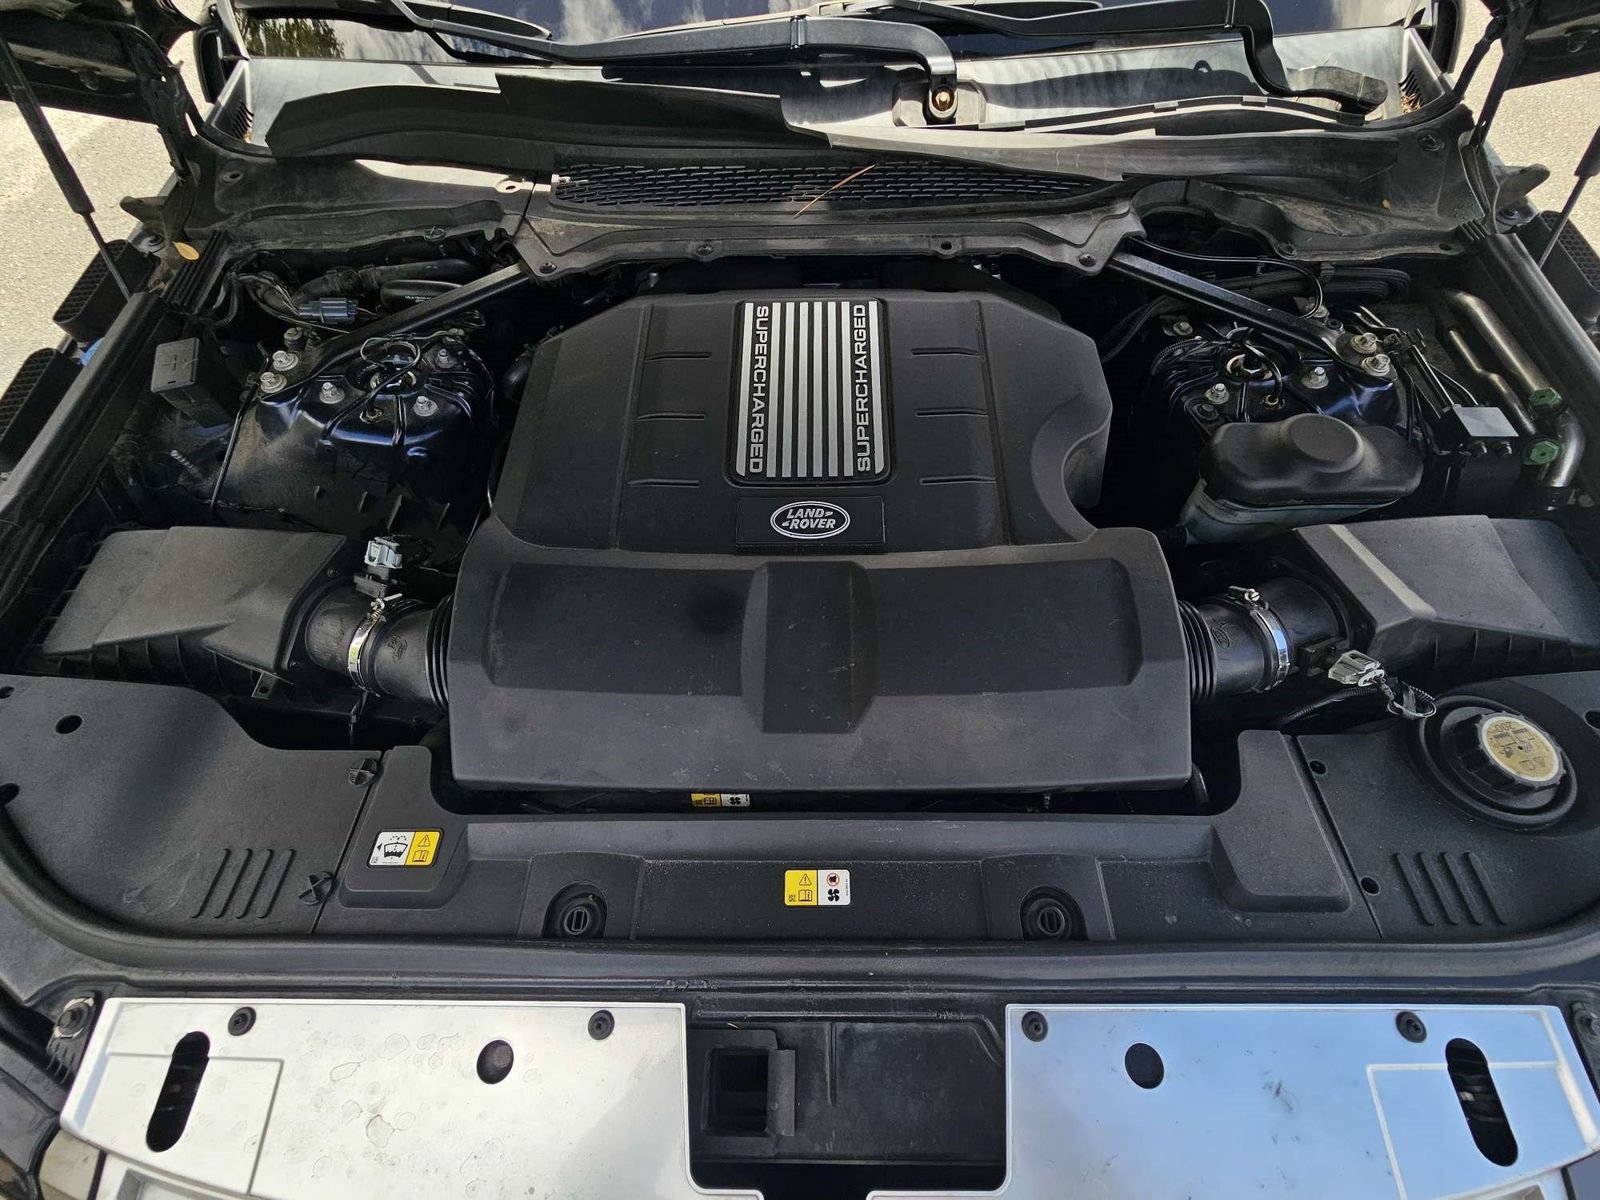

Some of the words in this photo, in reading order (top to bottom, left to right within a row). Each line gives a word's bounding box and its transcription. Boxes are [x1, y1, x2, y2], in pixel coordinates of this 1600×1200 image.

[749, 304, 769, 474] SUPERCHARGED
[853, 304, 871, 472] SUPERCHARGED
[786, 508, 824, 519] LAND
[789, 518, 836, 530] ROVER
